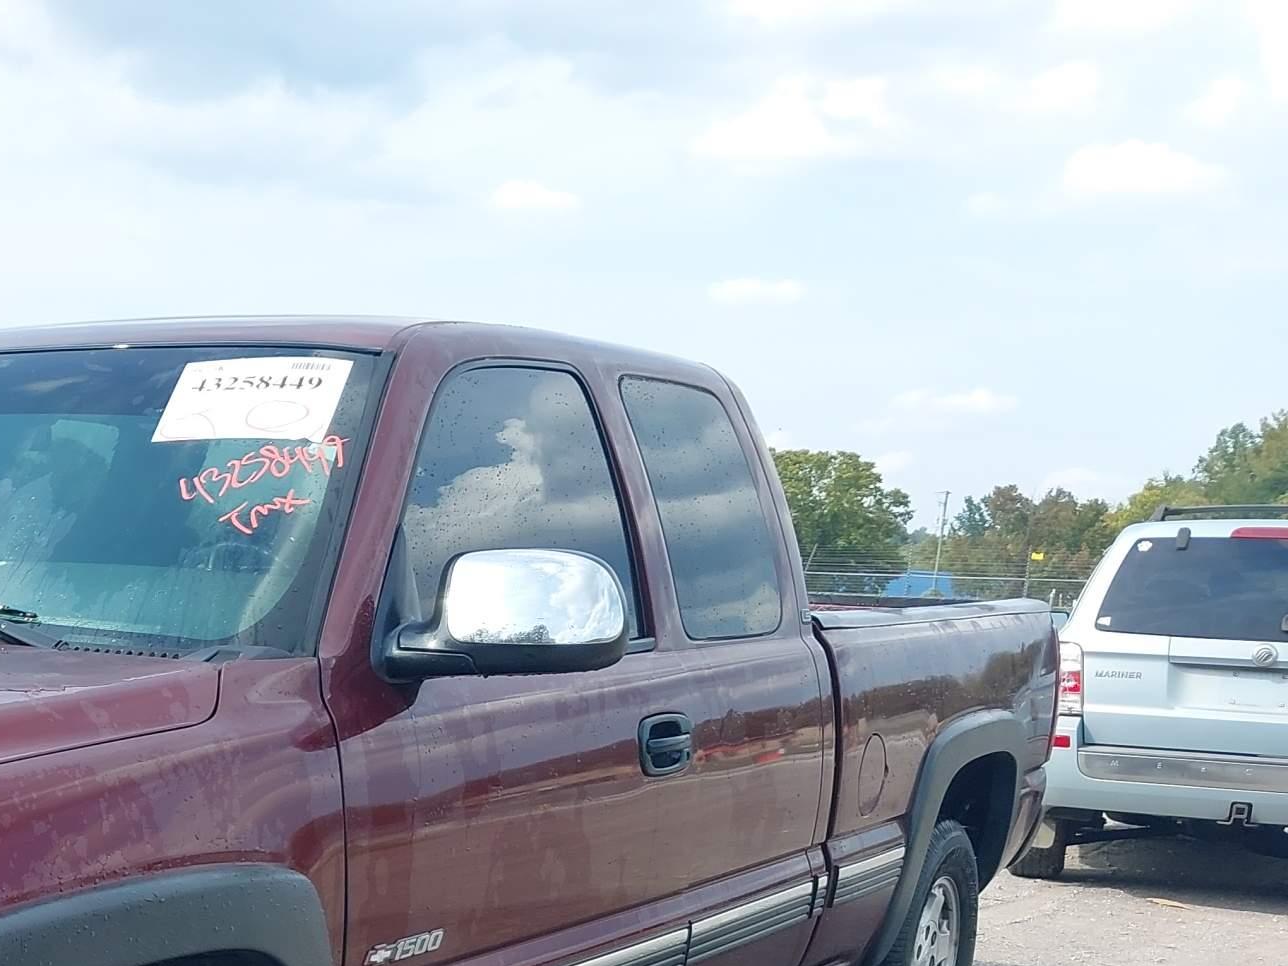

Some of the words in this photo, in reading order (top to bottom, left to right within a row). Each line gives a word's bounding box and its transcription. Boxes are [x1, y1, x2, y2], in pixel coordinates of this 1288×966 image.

[191, 374, 323, 392] 43258449
[179, 435, 350, 504] 43258449
[1094, 670, 1143, 680] MARINER
[393, 929, 445, 961] 1500
